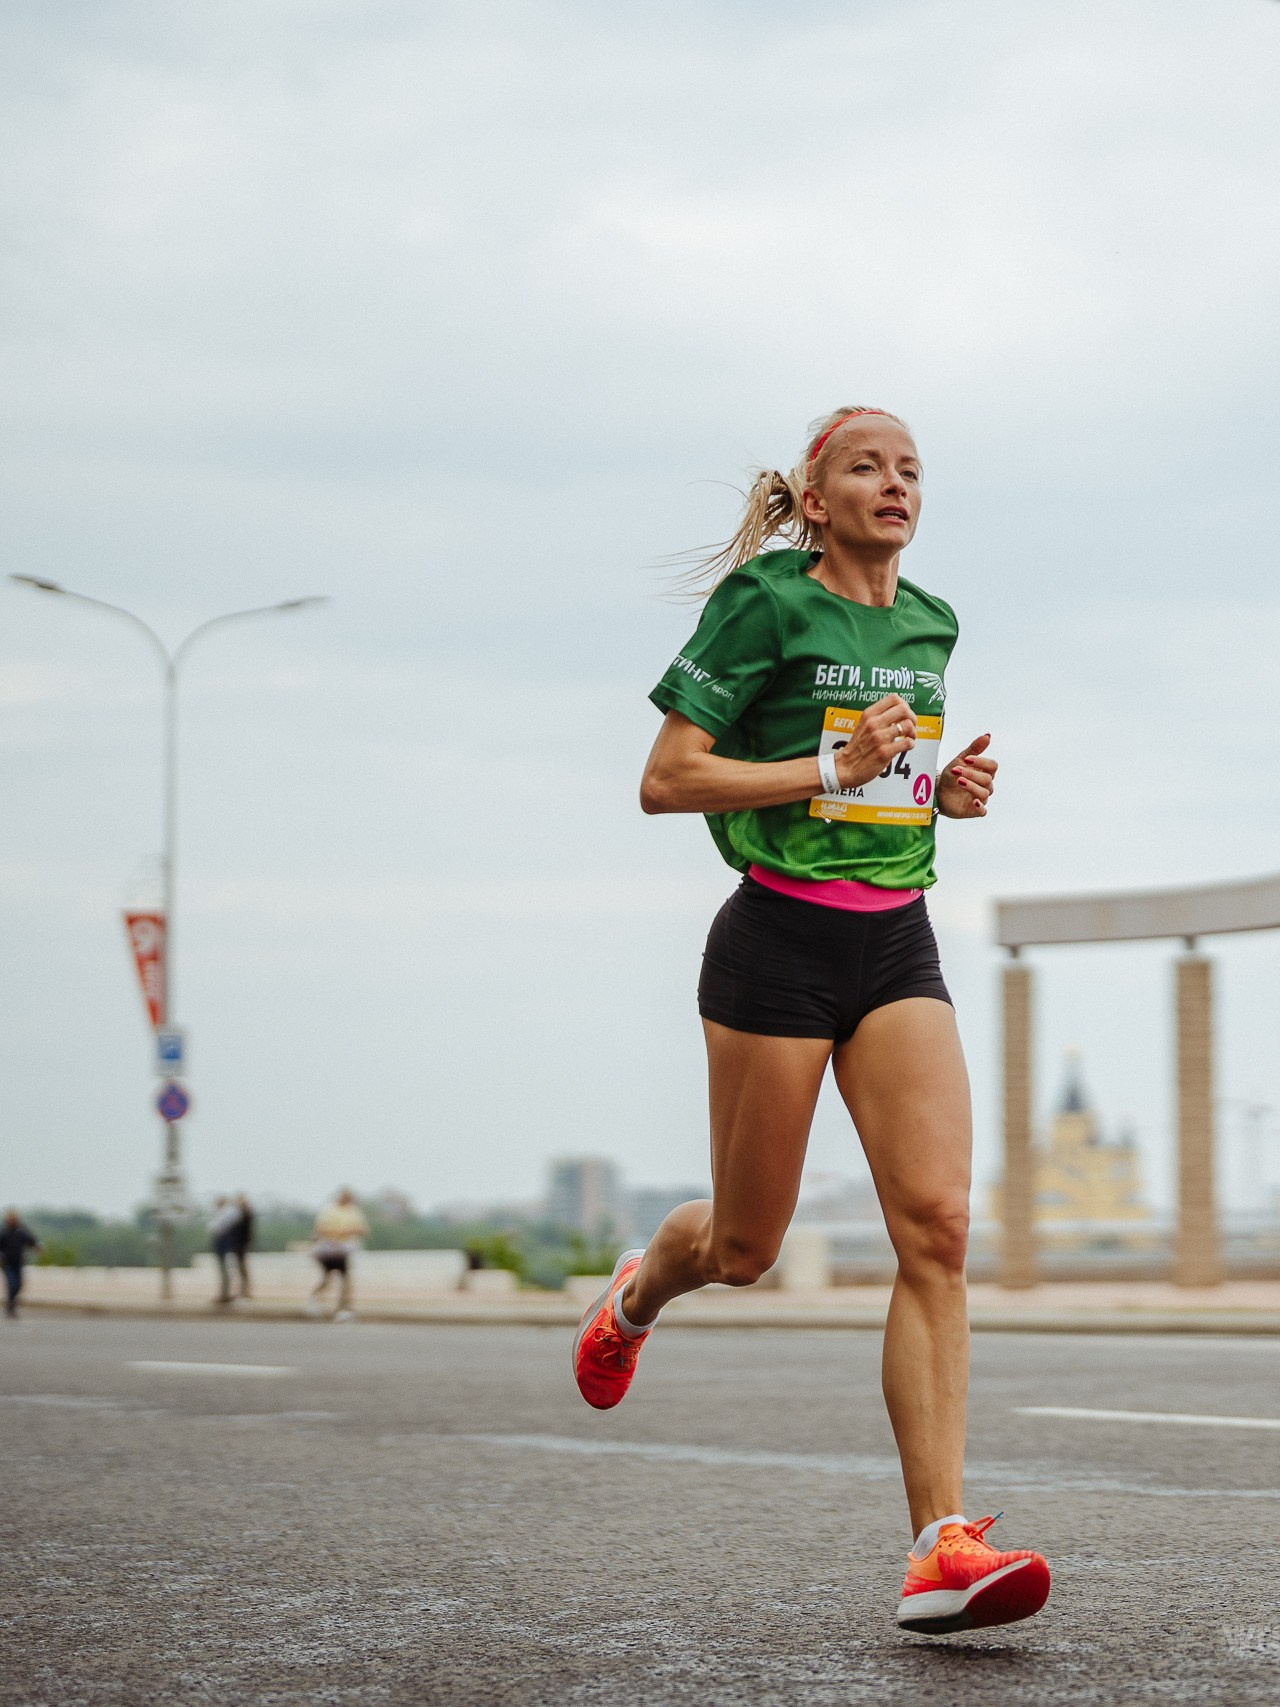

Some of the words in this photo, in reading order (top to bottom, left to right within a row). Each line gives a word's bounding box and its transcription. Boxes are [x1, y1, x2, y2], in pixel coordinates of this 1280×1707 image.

[815, 664, 865, 690] БЕГИ,
[871, 667, 915, 690] ГЕРОЙ!
[812, 688, 857, 701] НИЖНИЙ
